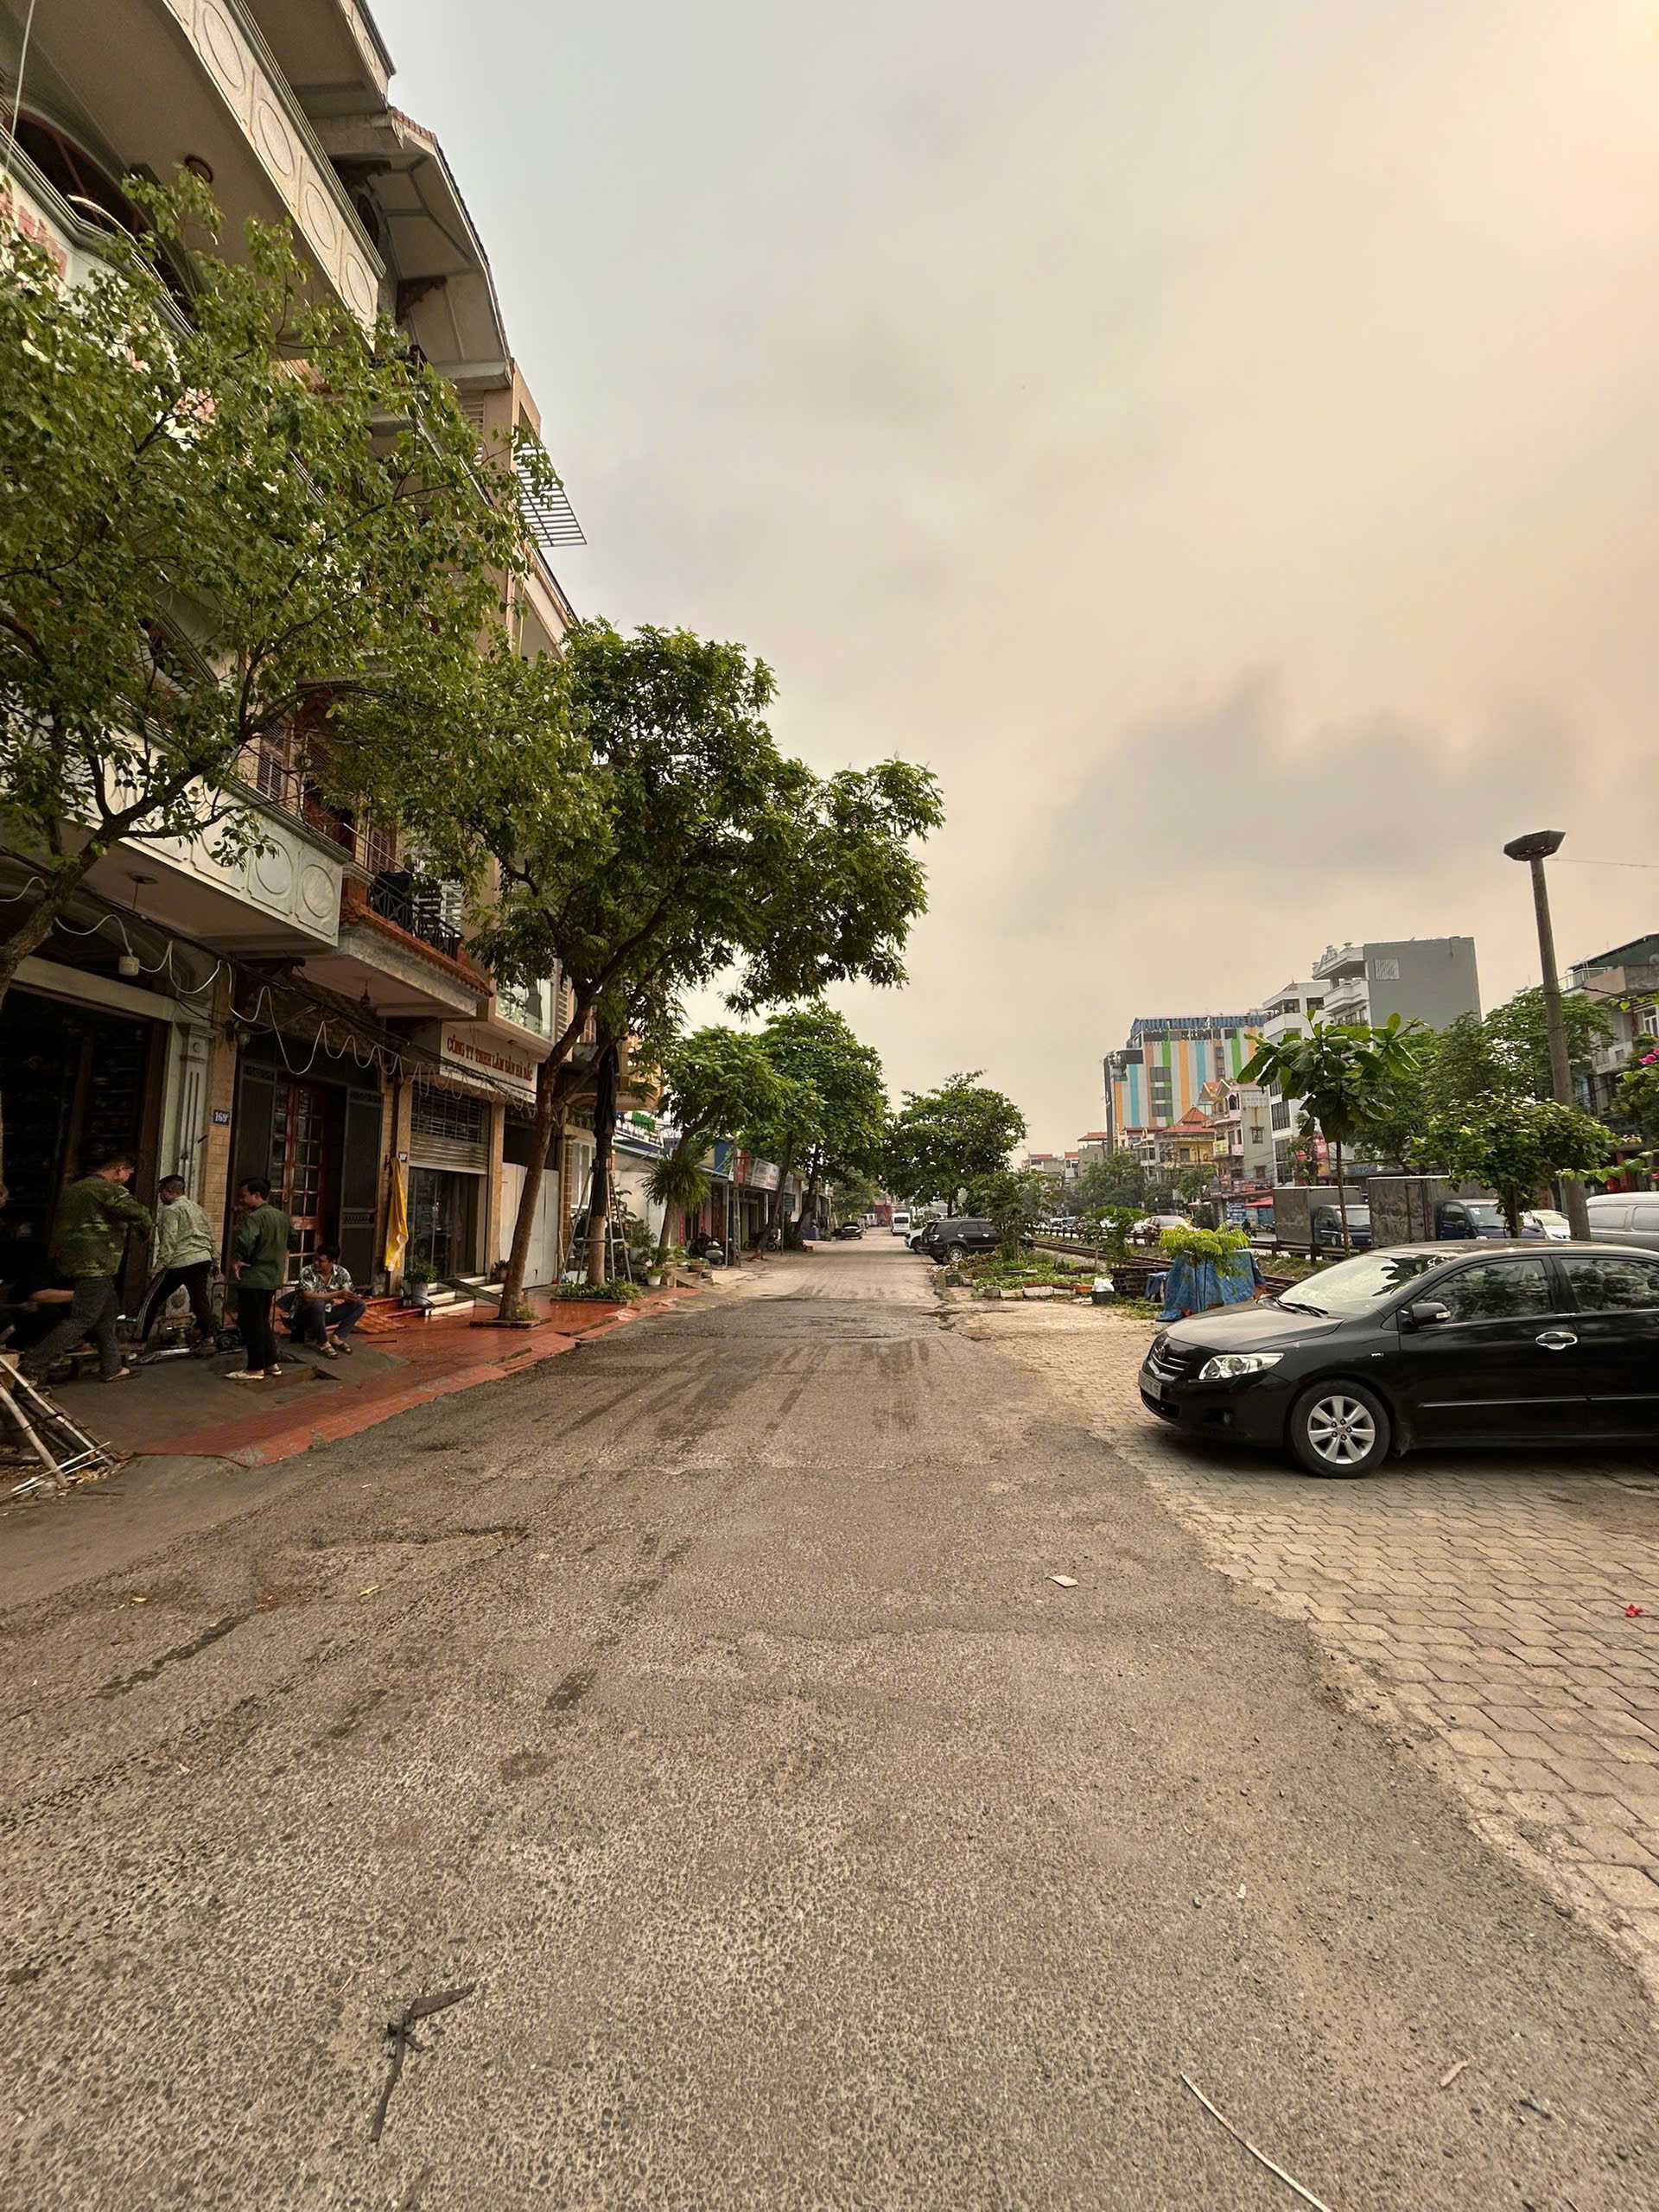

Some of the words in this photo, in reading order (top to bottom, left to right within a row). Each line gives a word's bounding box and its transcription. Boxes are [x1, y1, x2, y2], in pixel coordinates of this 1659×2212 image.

[447, 1035, 465, 1057] CÔNG
[466, 1045, 474, 1060] TY
[475, 1048, 492, 1067] TNHH
